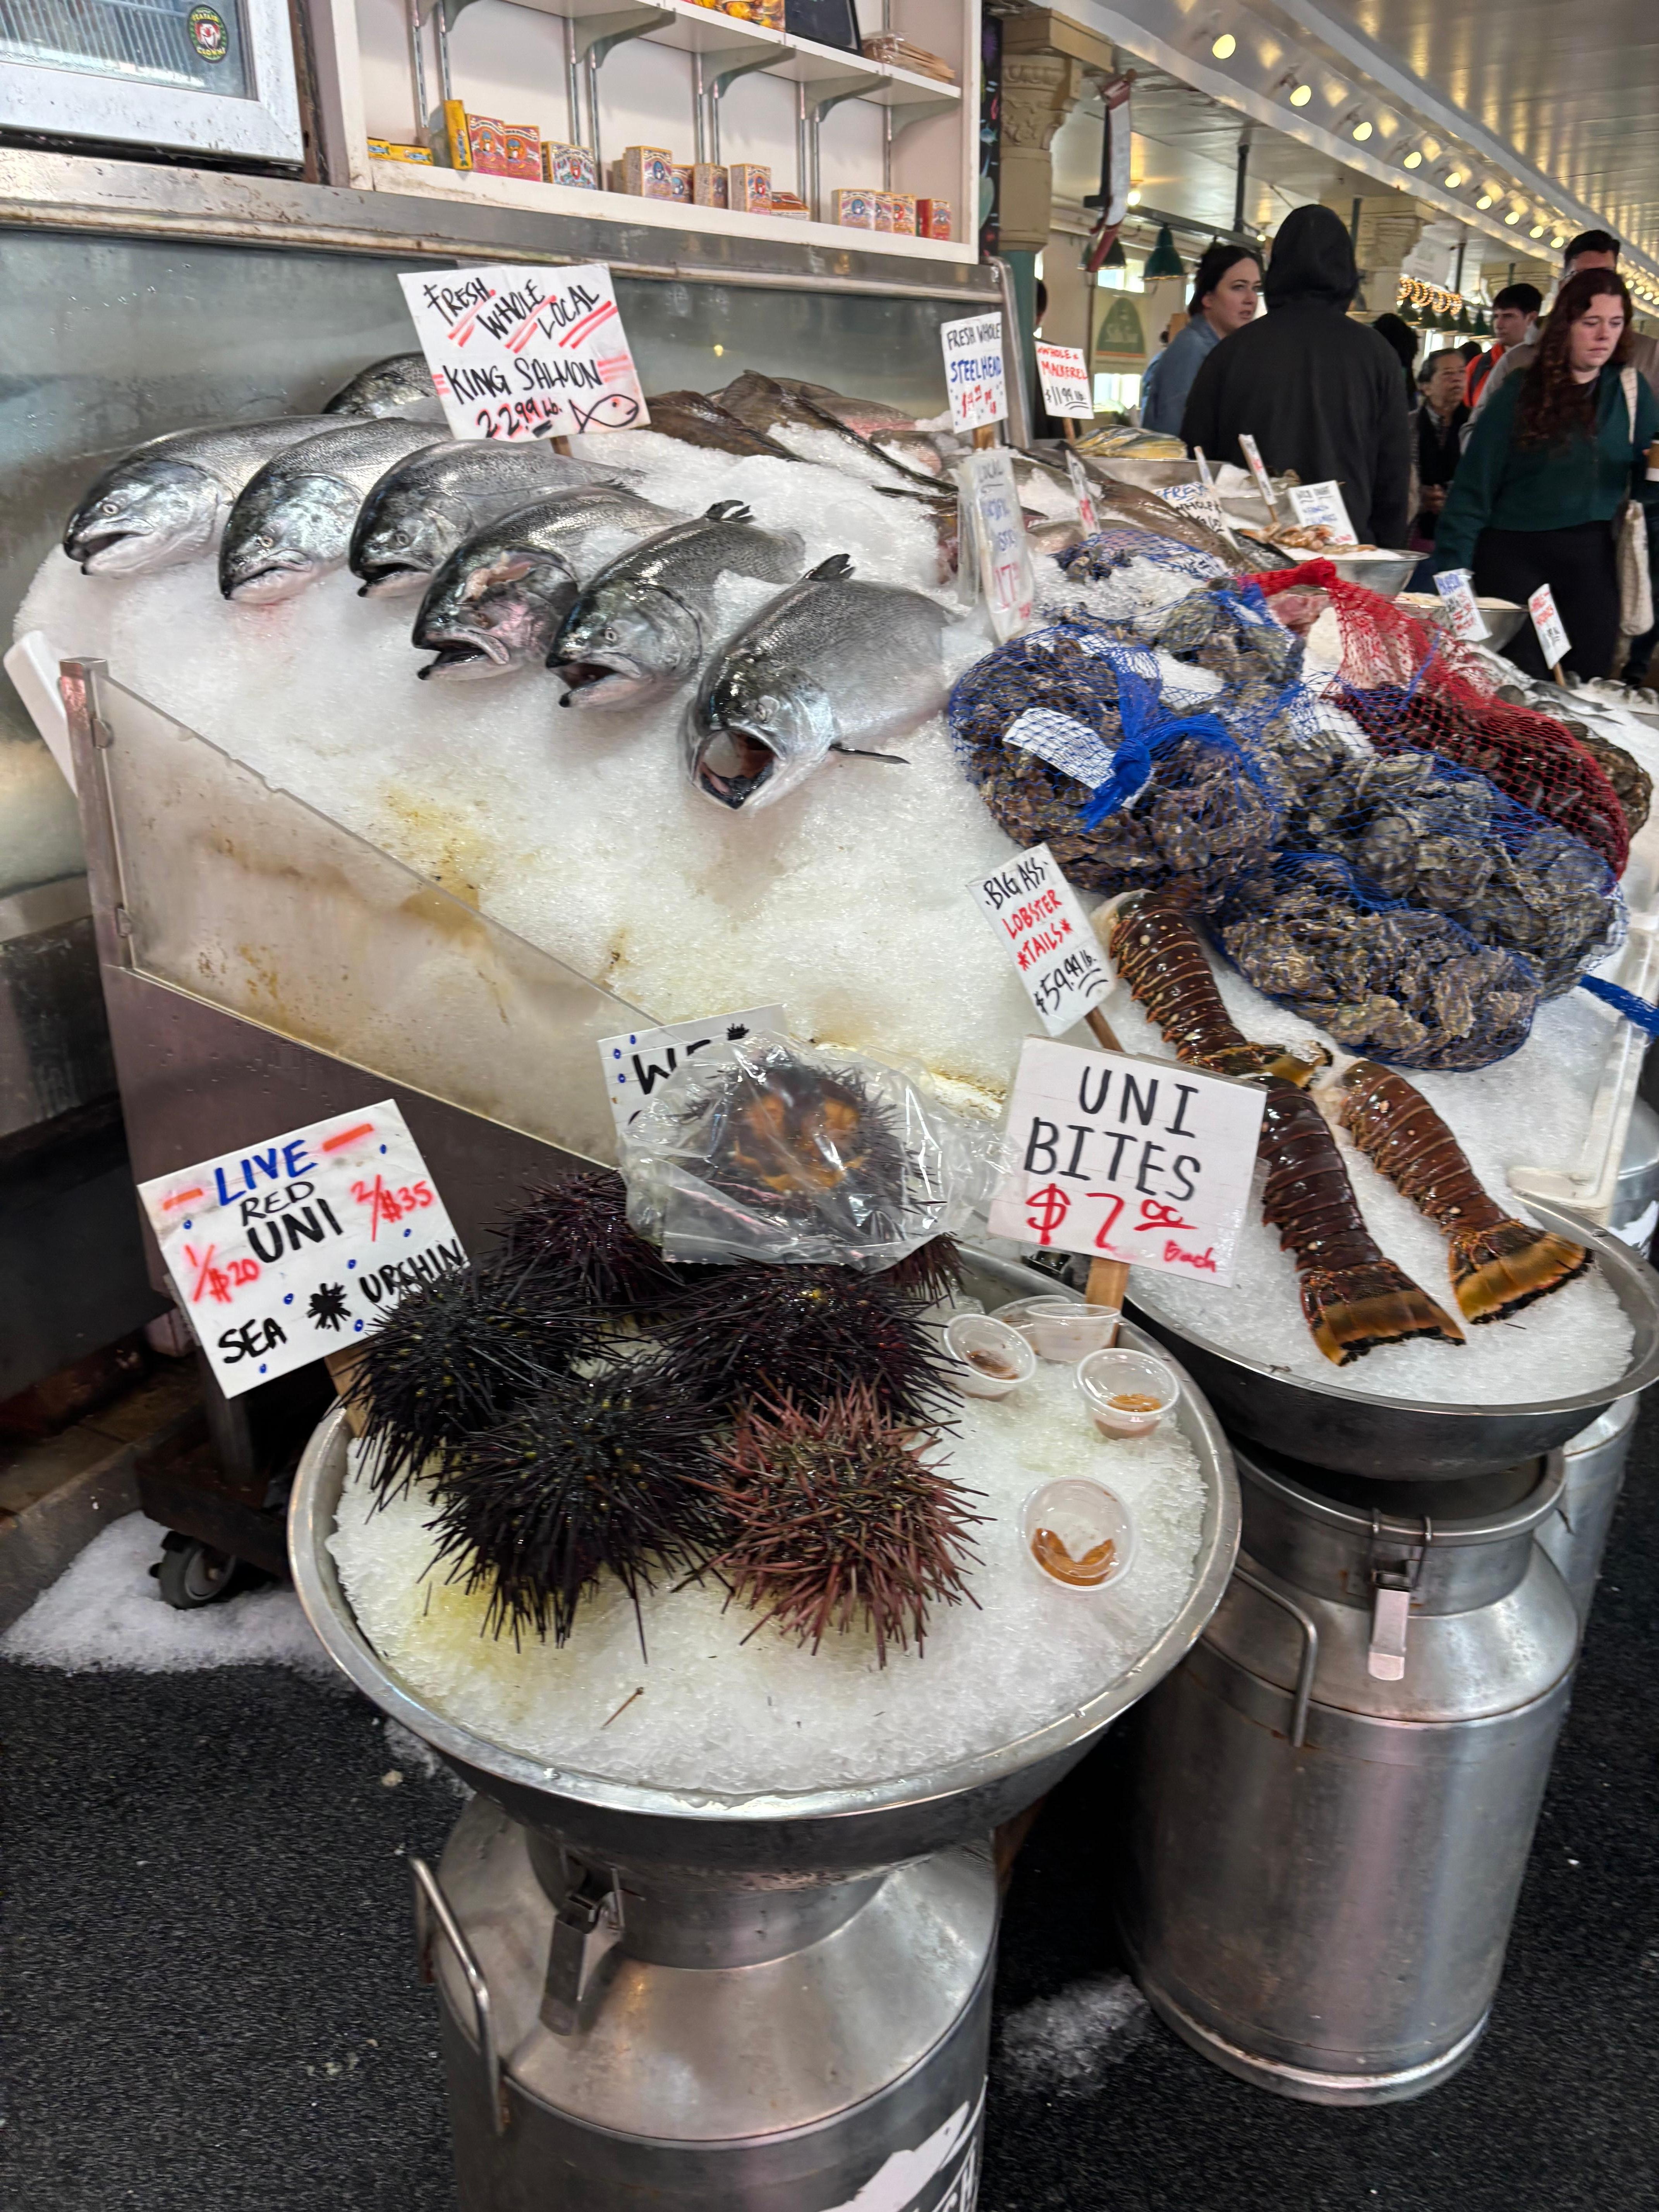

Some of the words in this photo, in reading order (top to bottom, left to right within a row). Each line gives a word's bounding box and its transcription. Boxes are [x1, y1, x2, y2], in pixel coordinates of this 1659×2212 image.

[423, 277, 489, 326] FRESH
[477, 280, 544, 340] WHOLE
[538, 285, 599, 339] LOCAL
[947, 327, 976, 350] FRESH
[976, 323, 1001, 343] WHOLE
[443, 365, 512, 405] KING
[514, 358, 603, 391] SALMON
[984, 872, 1023, 910] BIG
[1017, 857, 1046, 891] ASS
[1002, 890, 1063, 939] LOBSTER
[1079, 1066, 1199, 1138] UNI
[215, 1139, 318, 1206] LIVE
[1024, 1117, 1200, 1200] BITES
[239, 1182, 315, 1226] RED
[246, 1198, 344, 1263] UNI
[350, 1174, 434, 1242] 2/$35
[359, 1239, 466, 1304] URCHIN
[218, 1317, 288, 1364] SEA
